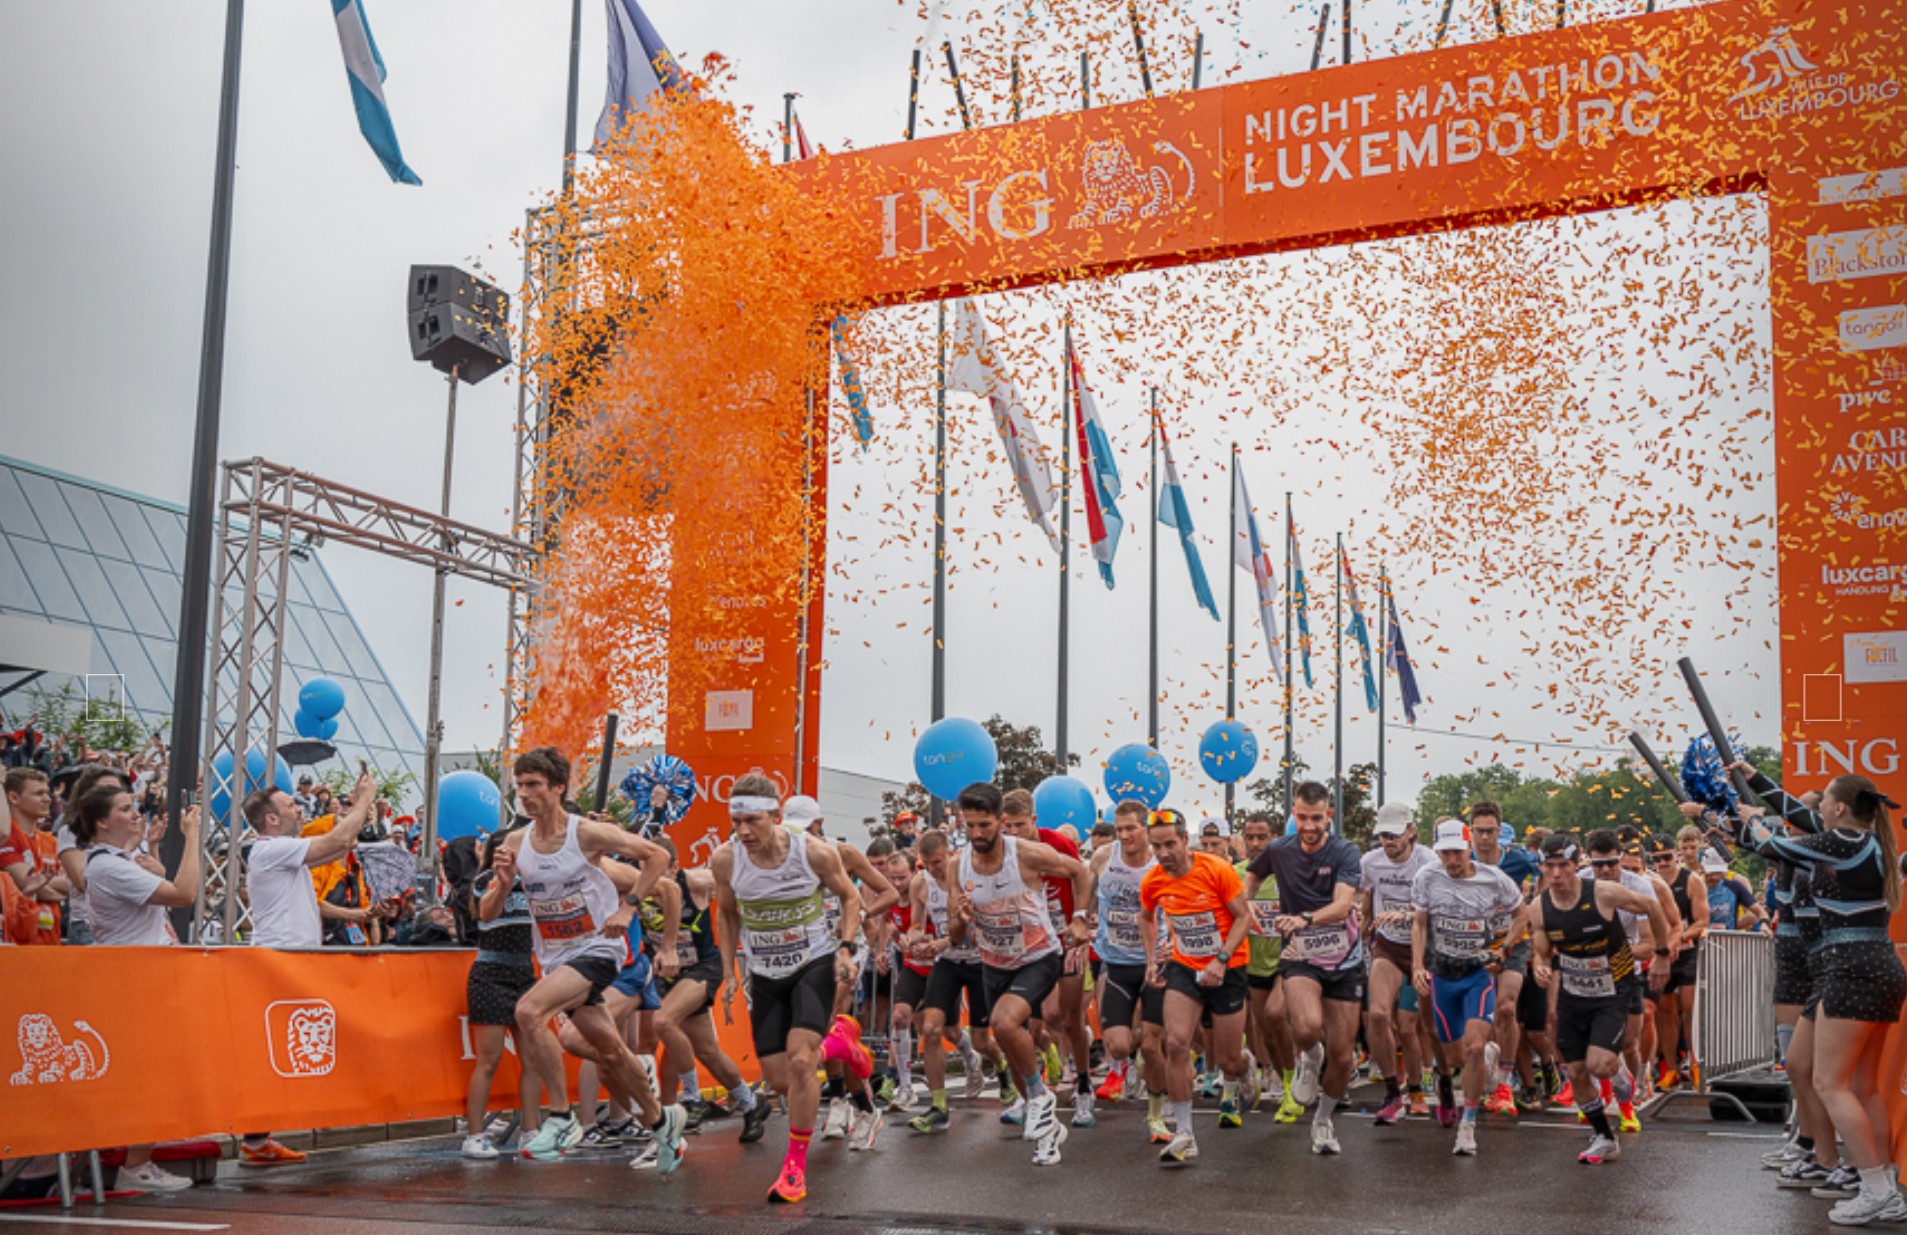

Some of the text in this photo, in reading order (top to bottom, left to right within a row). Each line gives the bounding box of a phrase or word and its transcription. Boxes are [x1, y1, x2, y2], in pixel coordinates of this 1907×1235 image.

[1245, 48, 1661, 146] NIGHT MARATHON
[1740, 79, 1900, 121] LUXEMBOURG
[1788, 73, 1847, 92] VILLE DE
[1244, 91, 1662, 194] LUXEMBOURG
[874, 169, 1055, 260] ING
[1792, 737, 1901, 777] ING
[752, 934, 781, 945] ING
[760, 952, 803, 969] 7420
